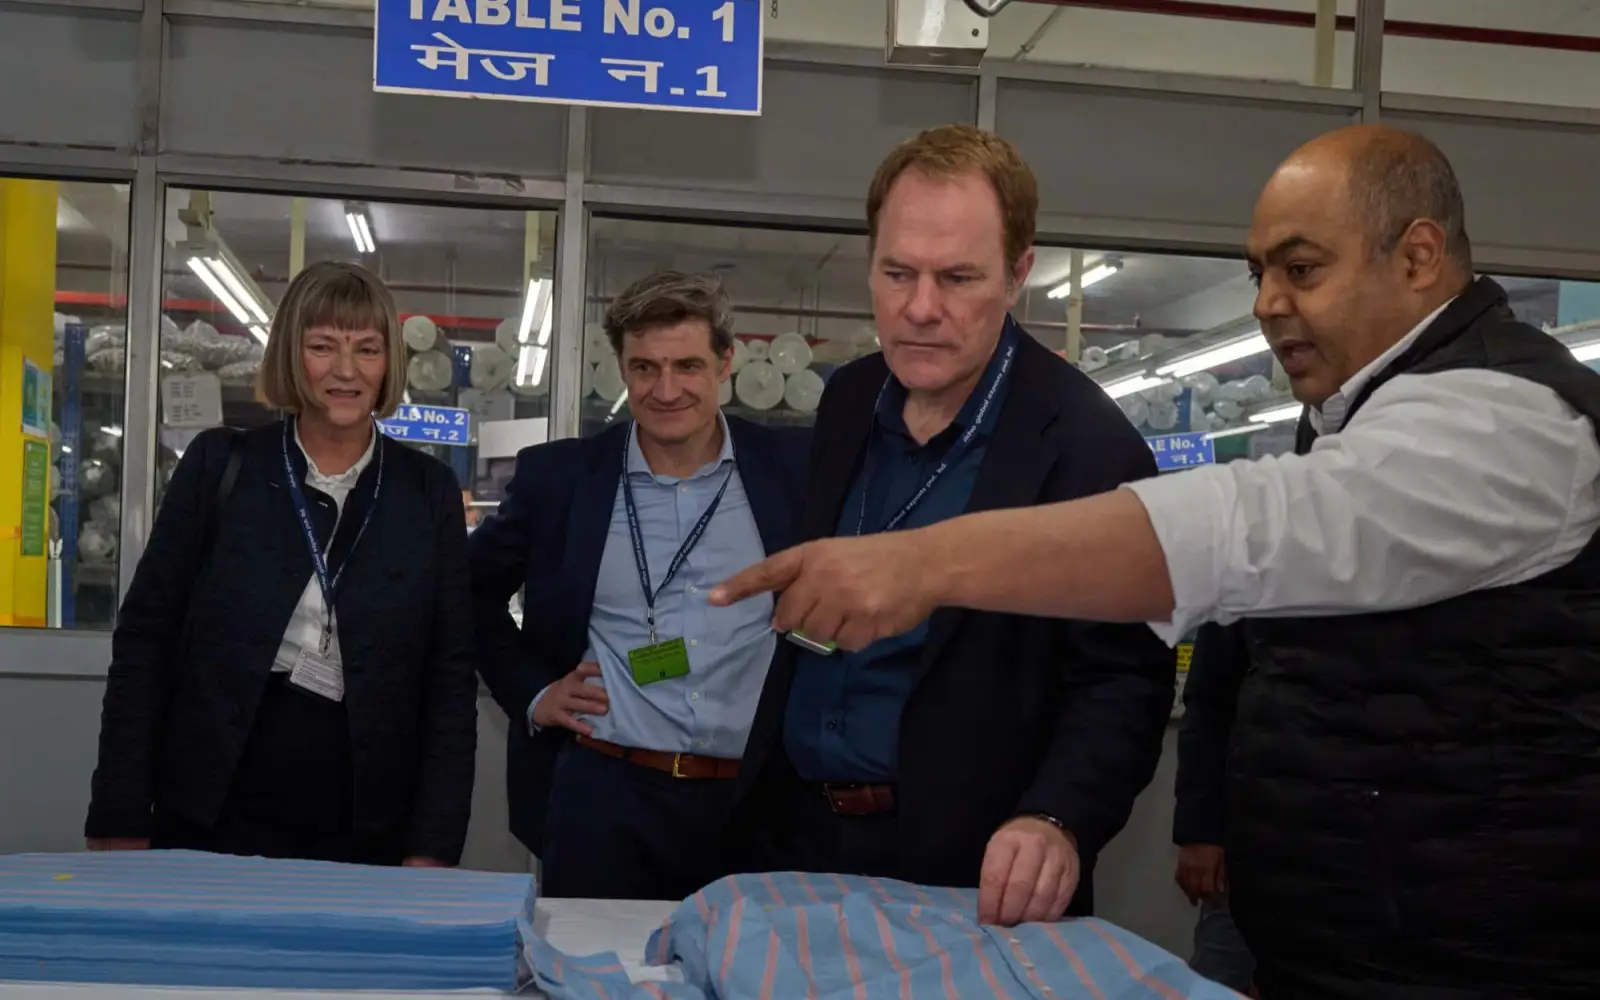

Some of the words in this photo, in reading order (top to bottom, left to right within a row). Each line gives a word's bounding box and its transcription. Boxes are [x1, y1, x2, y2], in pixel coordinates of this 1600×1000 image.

[603, 0, 690, 39] No.
[712, 2, 736, 42] 1
[410, 31, 556, 86] मेज
[423, 410, 450, 424] No.
[454, 412, 465, 425] 2
[1170, 437, 1196, 450] No.
